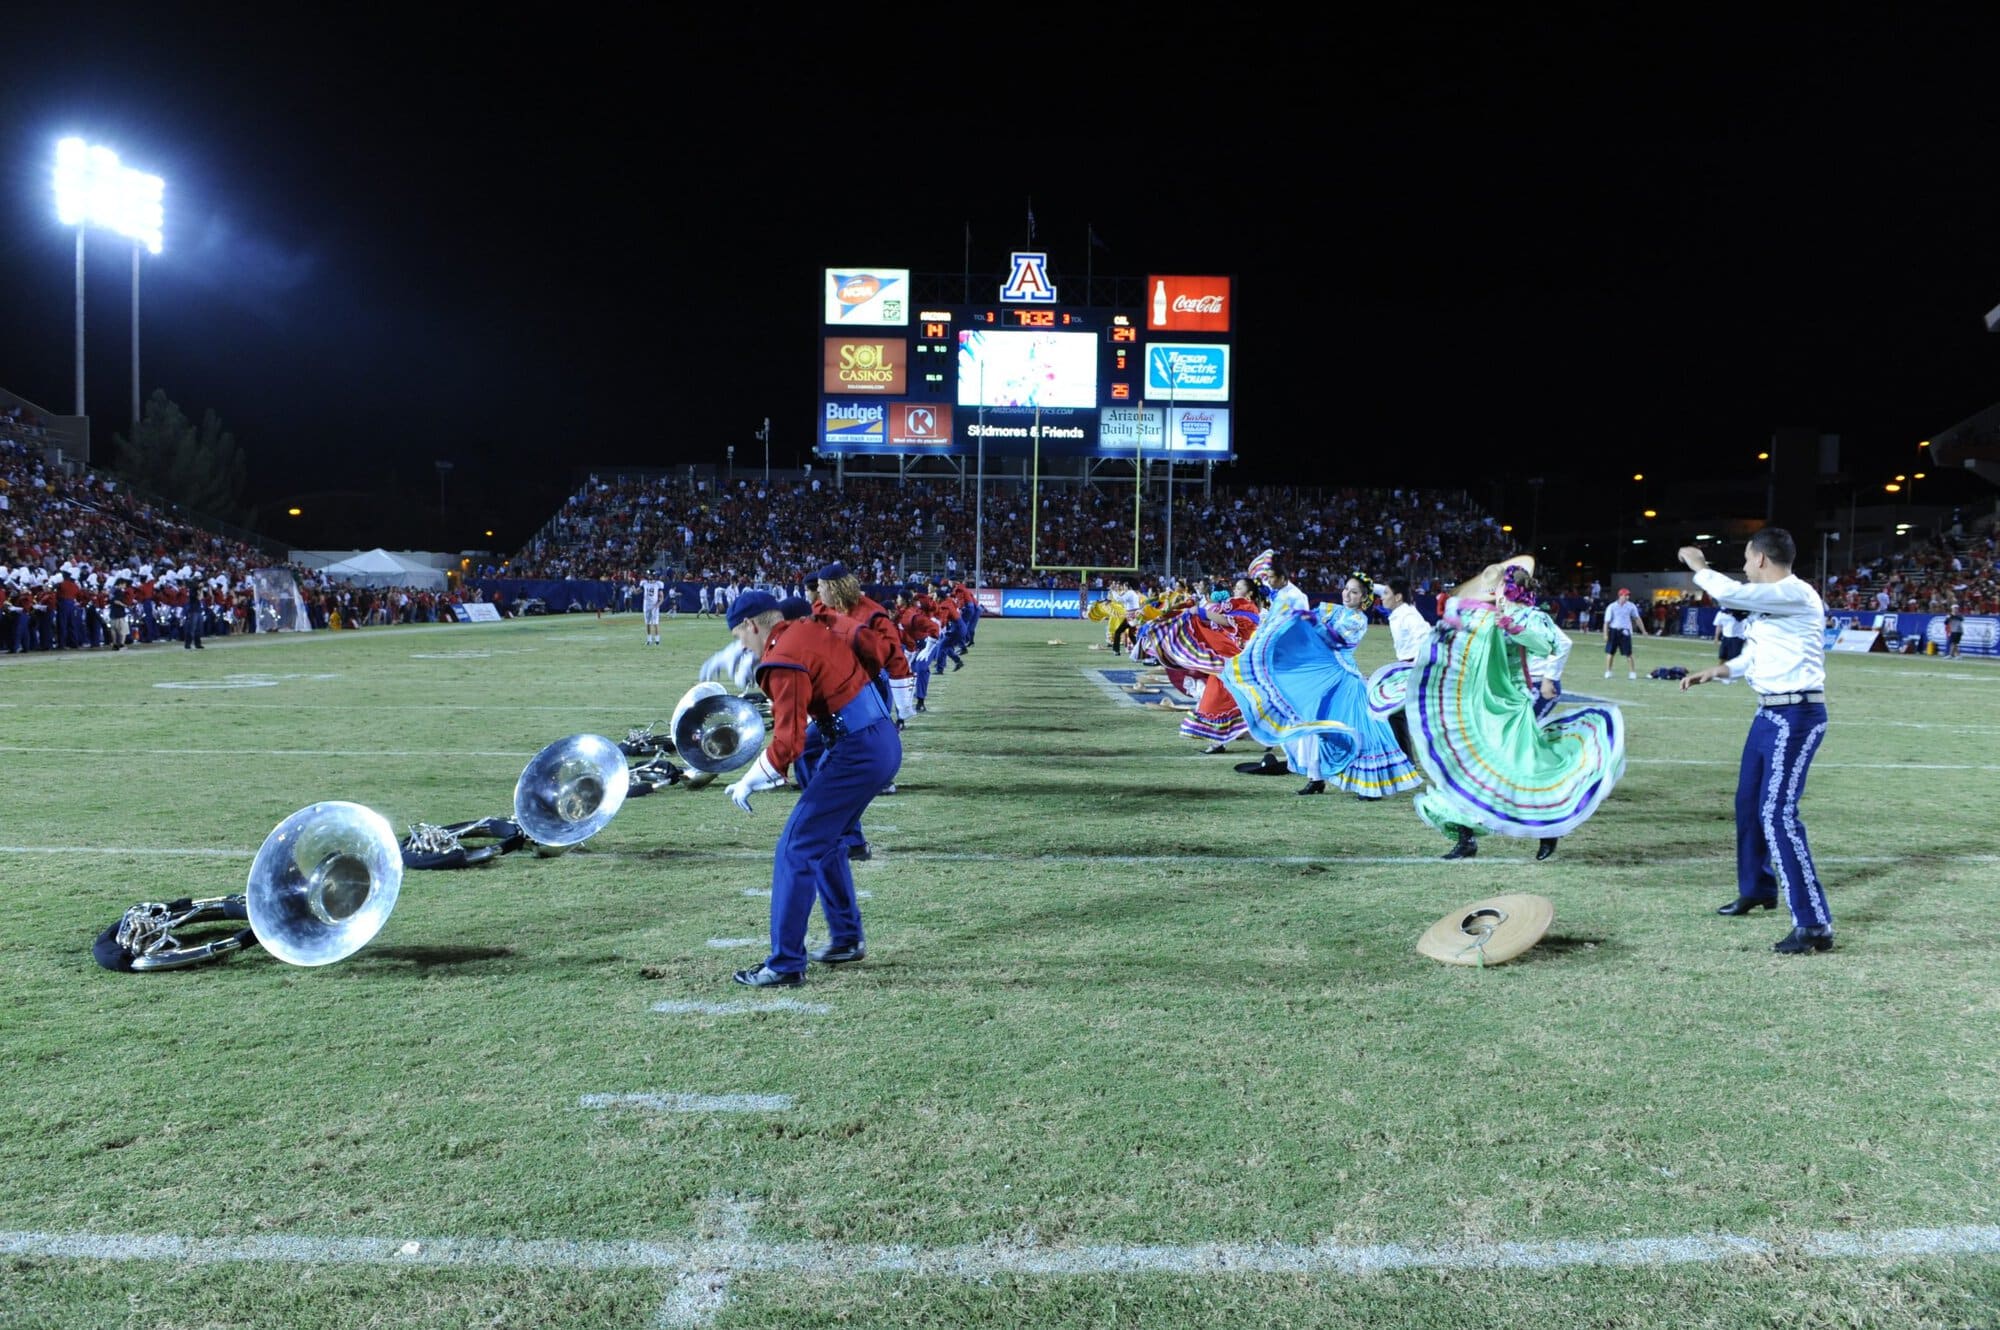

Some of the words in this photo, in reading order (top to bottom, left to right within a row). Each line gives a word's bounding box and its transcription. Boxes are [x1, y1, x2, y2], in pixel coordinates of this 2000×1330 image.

[1000, 252, 1056, 302] A
[986, 312, 994, 322] 3
[1014, 310, 1054, 326] 7:32
[1062, 314, 1070, 324] 3
[927, 324, 943, 337] 14
[1113, 328, 1135, 341] 24
[840, 344, 892, 370] SOL
[1117, 357, 1125, 368] 3
[1168, 351, 1207, 363] Tucson
[1172, 363, 1217, 374] Electric
[840, 370, 893, 381] CASINOS
[1177, 373, 1216, 384] Power
[826, 402, 883, 424] Budget
[1109, 409, 1154, 422] Arizona
[967, 425, 1027, 437] Skidmores
[1029, 426, 1040, 437] &
[1041, 426, 1084, 438] Friends
[1100, 423, 1132, 437] Daily
[1136, 423, 1160, 435] Star
